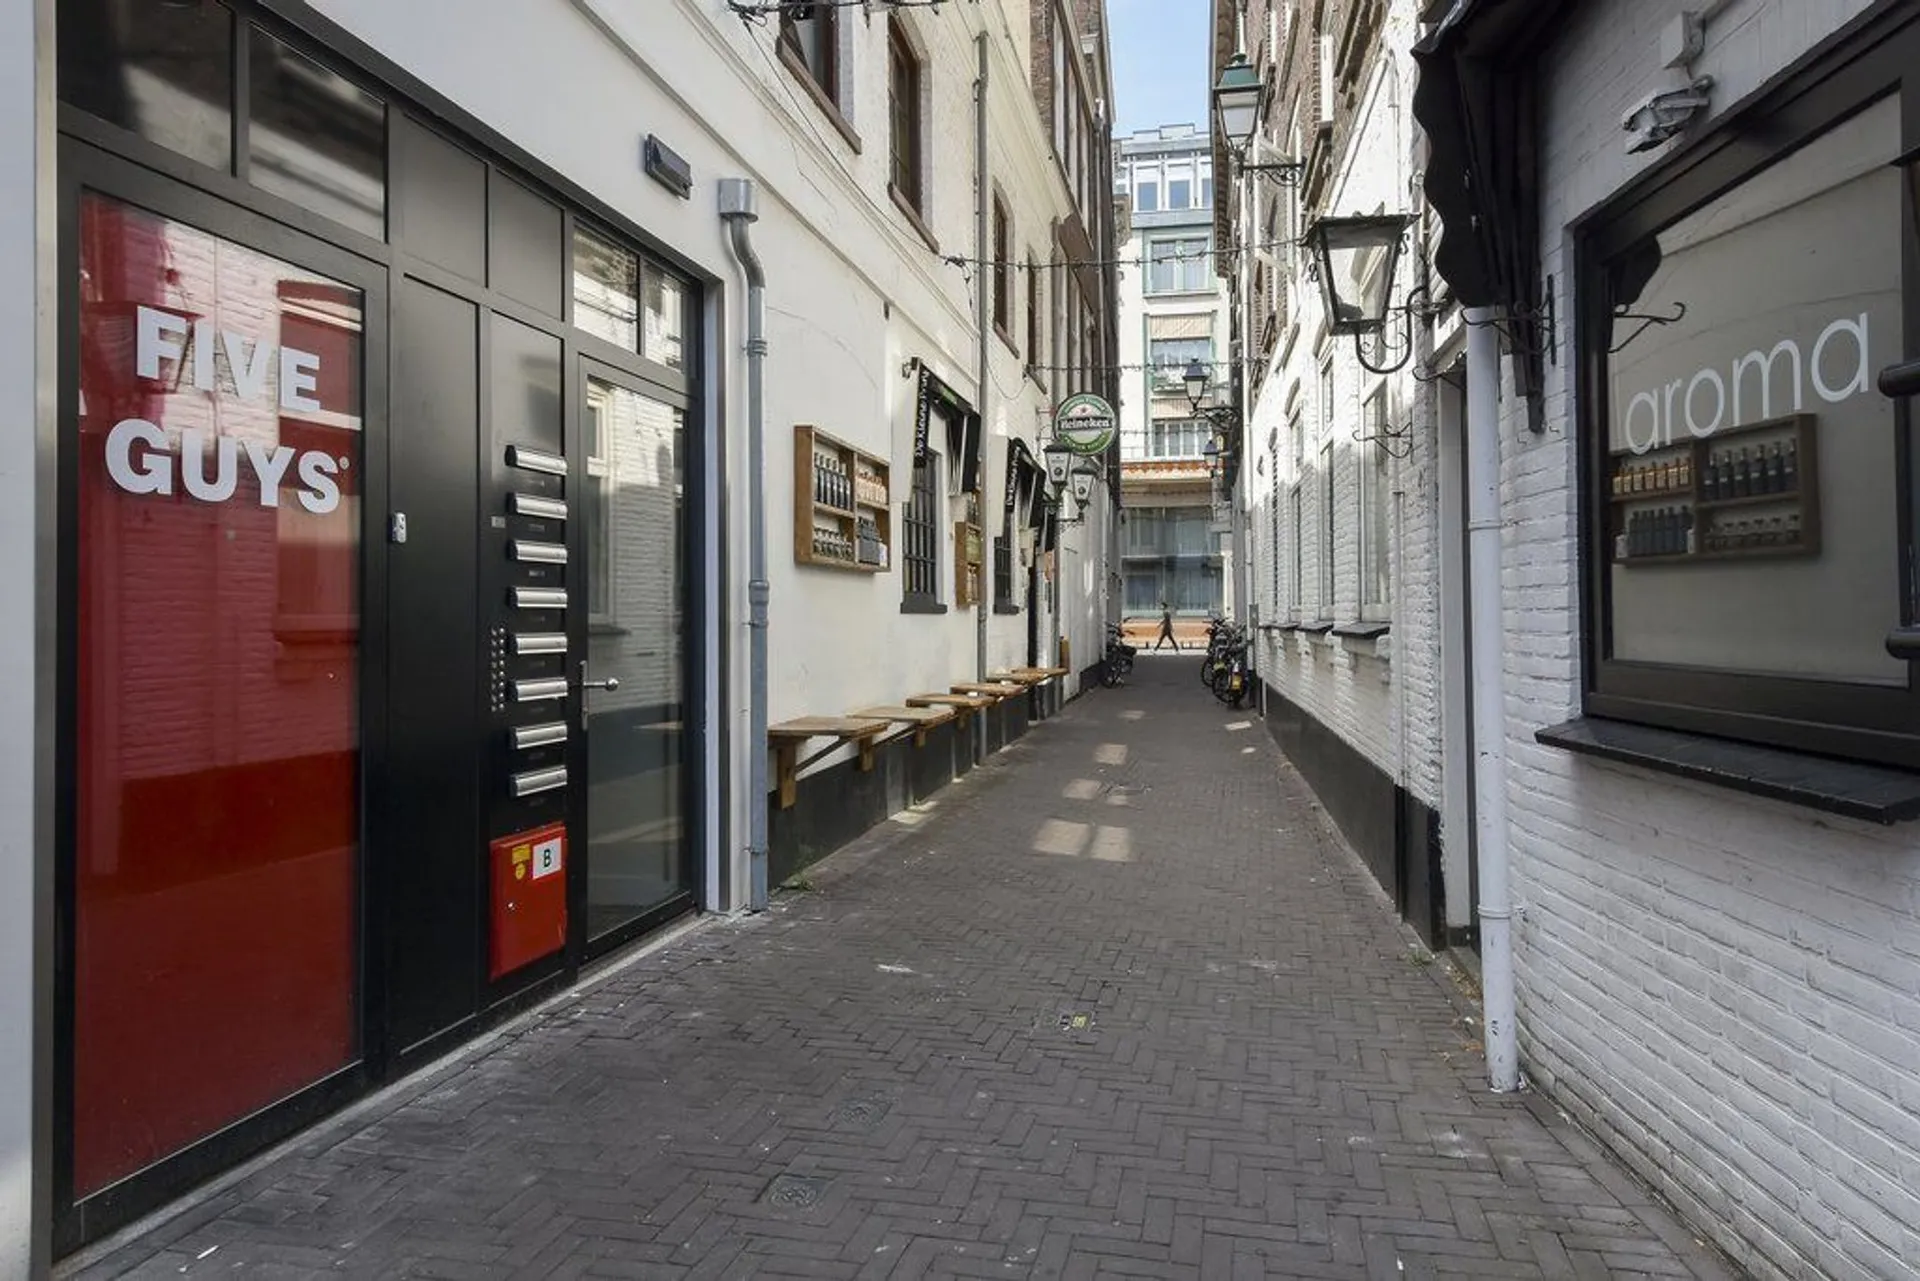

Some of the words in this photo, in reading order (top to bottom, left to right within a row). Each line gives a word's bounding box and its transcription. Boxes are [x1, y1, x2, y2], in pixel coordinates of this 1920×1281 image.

[136, 306, 320, 412] FIVE
[1624, 312, 1869, 456] aroma
[105, 418, 341, 514] GUYS
[1060, 418, 1110, 429] Heineken
[544, 848, 552, 868] B
